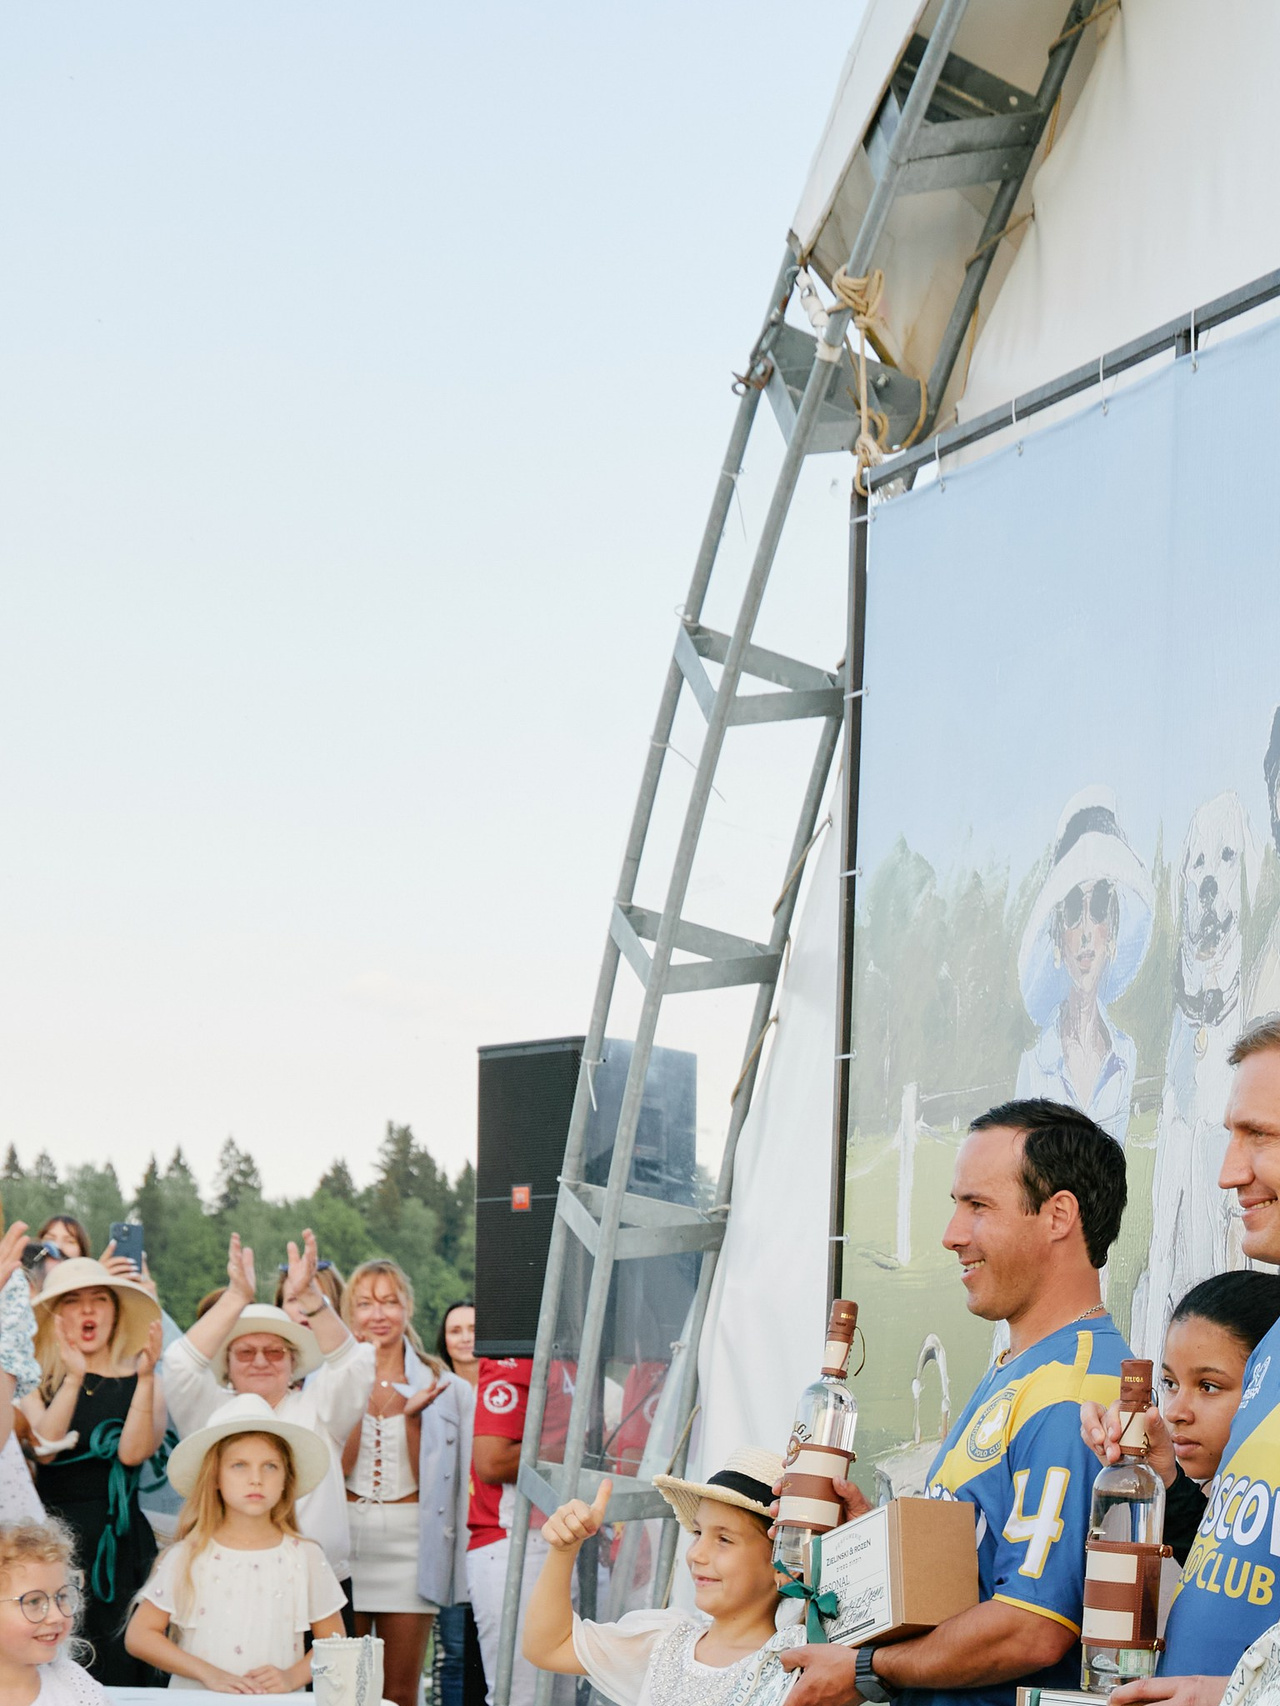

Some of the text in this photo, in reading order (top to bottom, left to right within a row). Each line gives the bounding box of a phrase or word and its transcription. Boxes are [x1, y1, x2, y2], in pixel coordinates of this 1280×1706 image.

[854, 1538, 872, 1553] ROZEN
[1002, 1466, 1071, 1579] 4
[1196, 1551, 1276, 1606] CLUB
